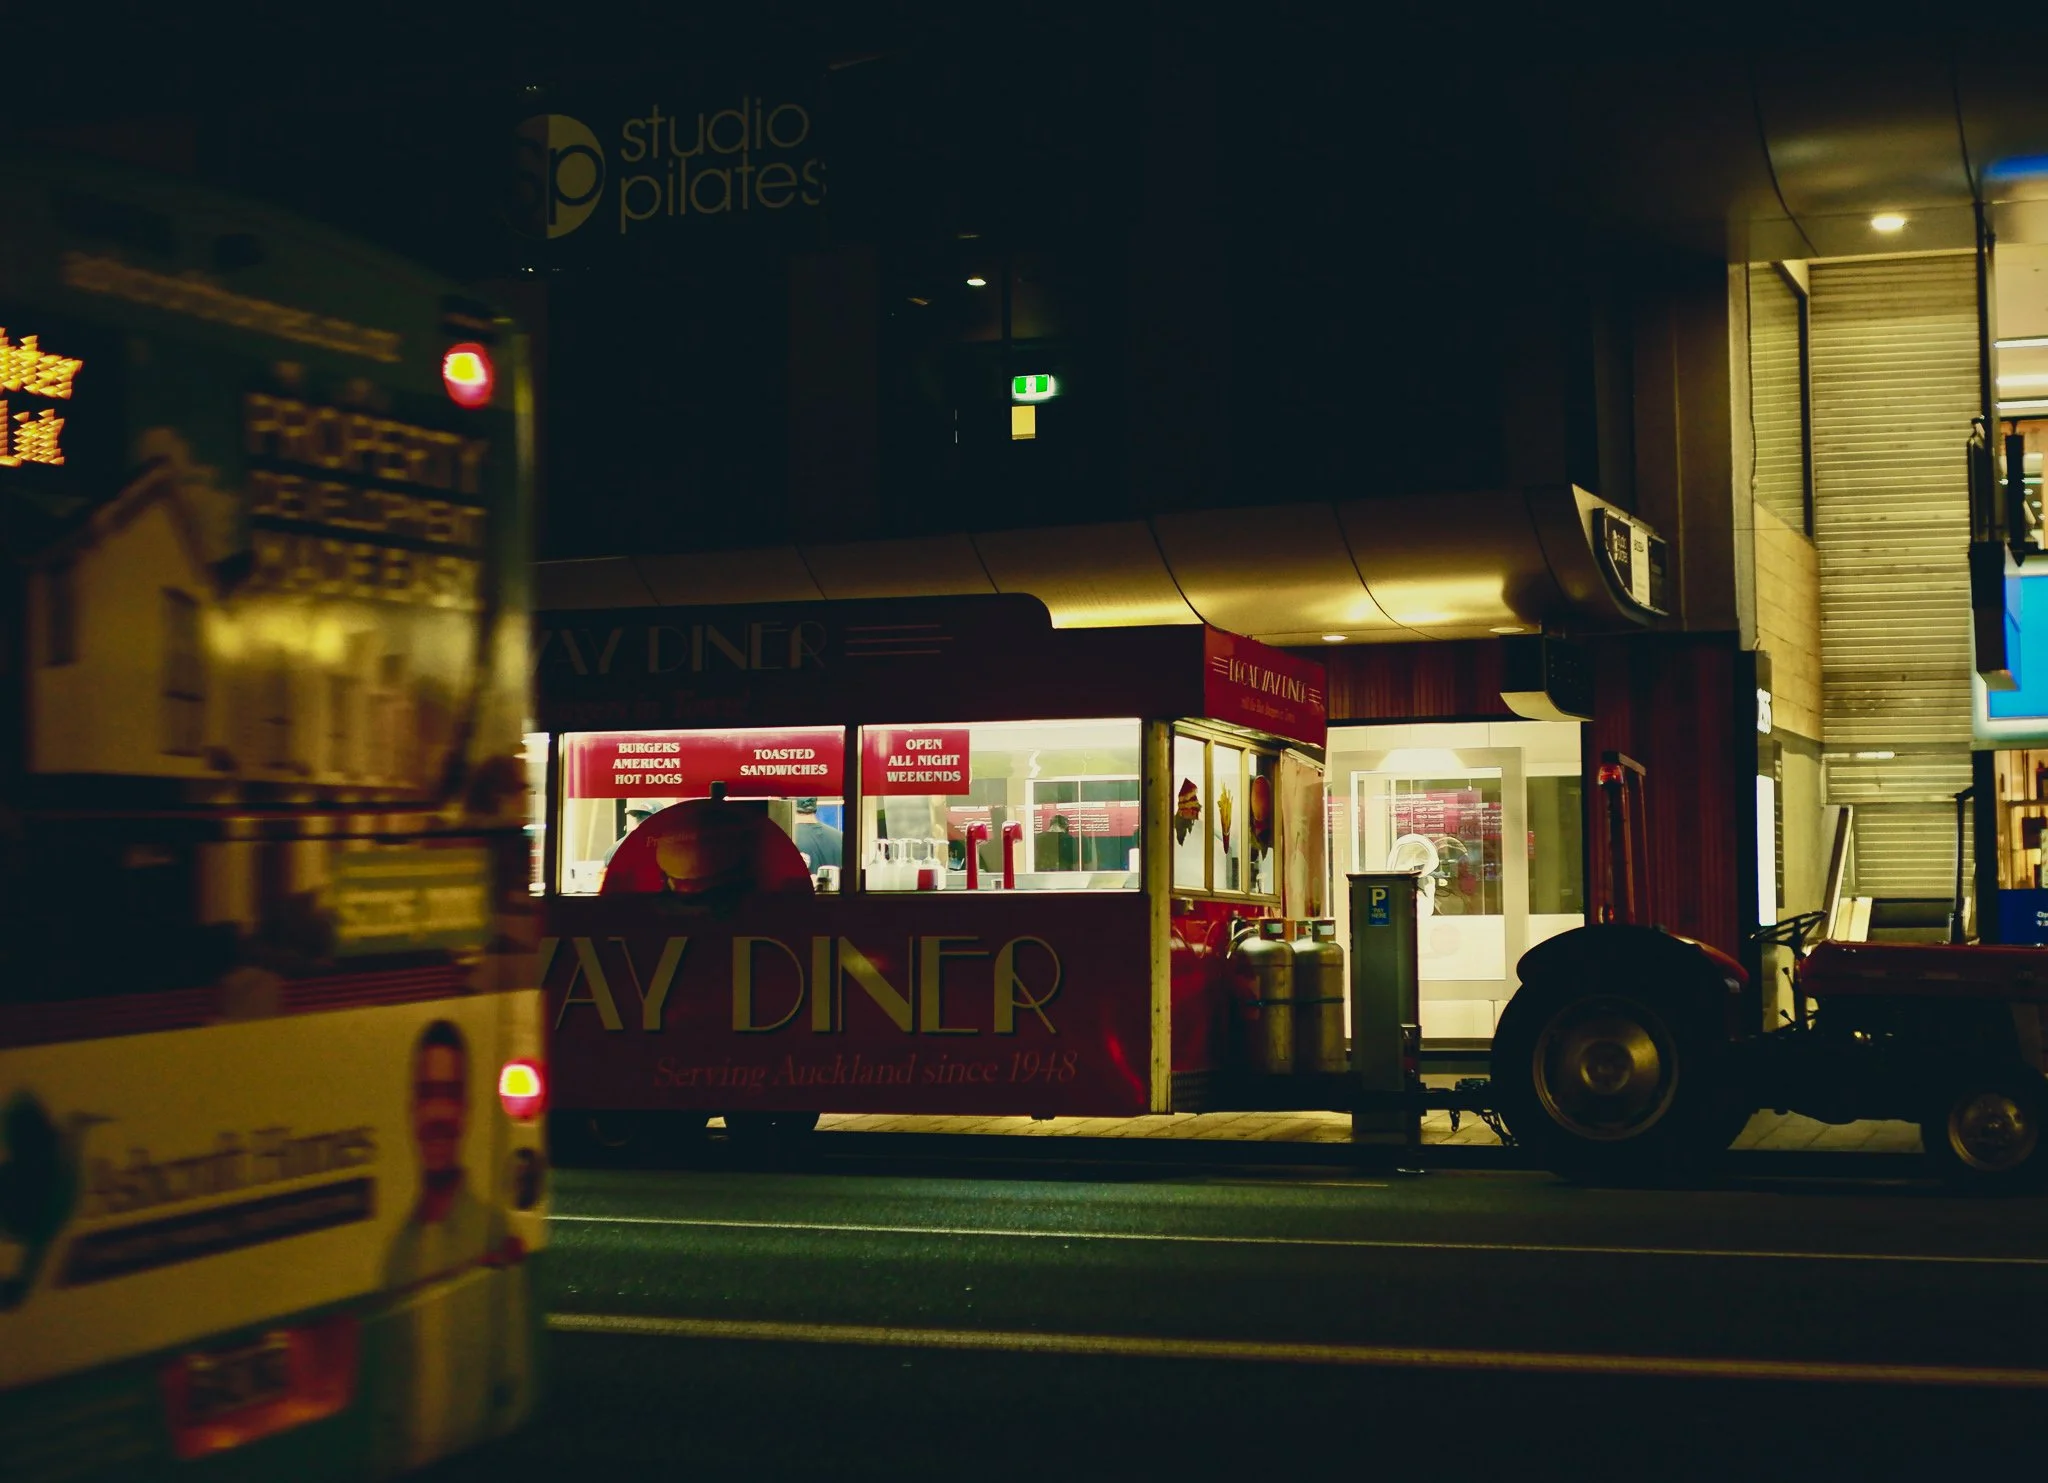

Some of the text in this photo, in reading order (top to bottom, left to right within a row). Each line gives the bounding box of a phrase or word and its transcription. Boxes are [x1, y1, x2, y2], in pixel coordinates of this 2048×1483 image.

[619, 95, 810, 163] studio
[619, 153, 828, 235] pilates
[245, 391, 490, 495] PROPERTY
[647, 619, 829, 674] DINER
[617, 741, 681, 755] BURGERS
[904, 737, 943, 751] OPEN
[752, 747, 816, 761] TOASTED
[887, 753, 961, 767] ALL NIGHT
[611, 757, 681, 770] AMERICAN
[739, 762, 829, 777] SANDWICHES
[613, 772, 684, 786] HOT DOGS
[886, 769, 962, 783] WEEKENDS
[1371, 888, 1387, 907] P
[731, 934, 1063, 1035] DINER
[652, 1049, 1079, 1094] Serving Auckland since 1948
